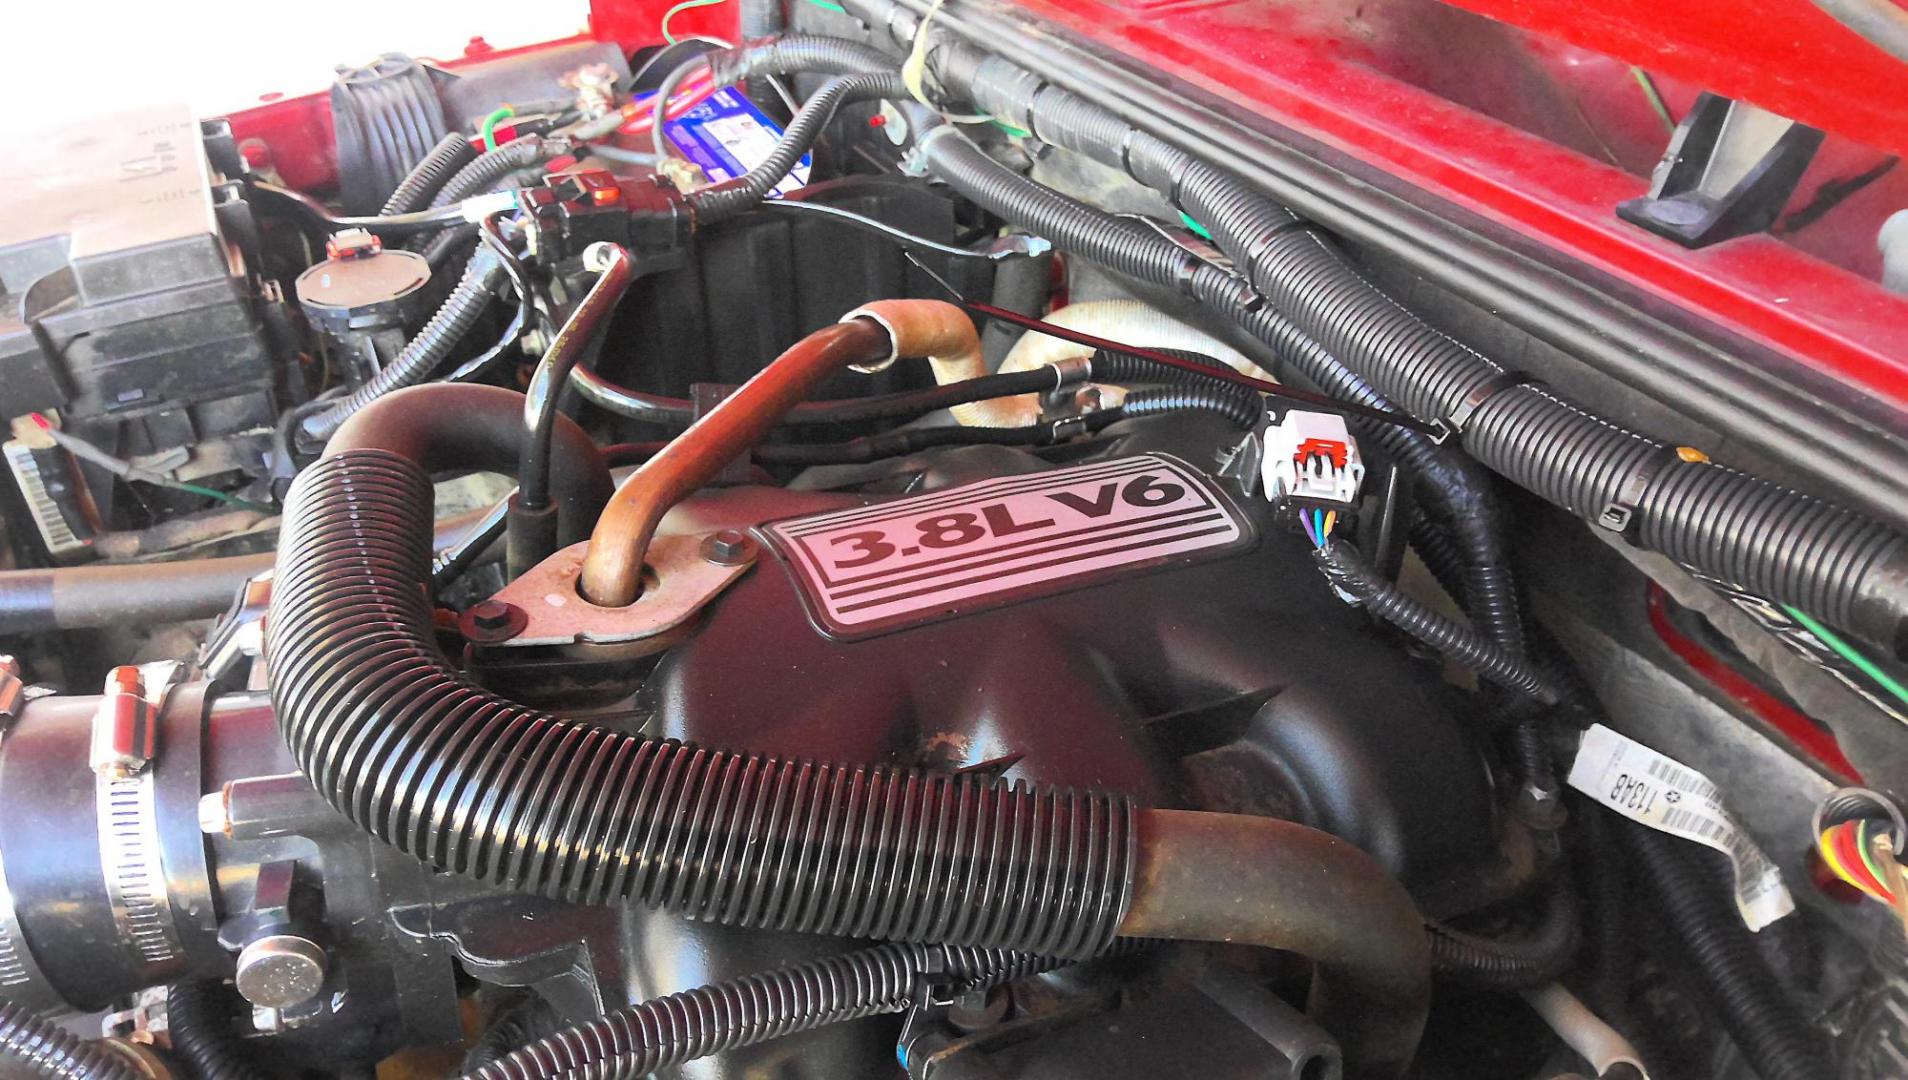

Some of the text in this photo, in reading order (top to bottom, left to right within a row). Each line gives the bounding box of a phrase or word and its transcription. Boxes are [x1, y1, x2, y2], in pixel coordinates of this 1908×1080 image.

[829, 474, 1187, 570] 3.8L V6
[1610, 773, 1659, 816] 113AB
